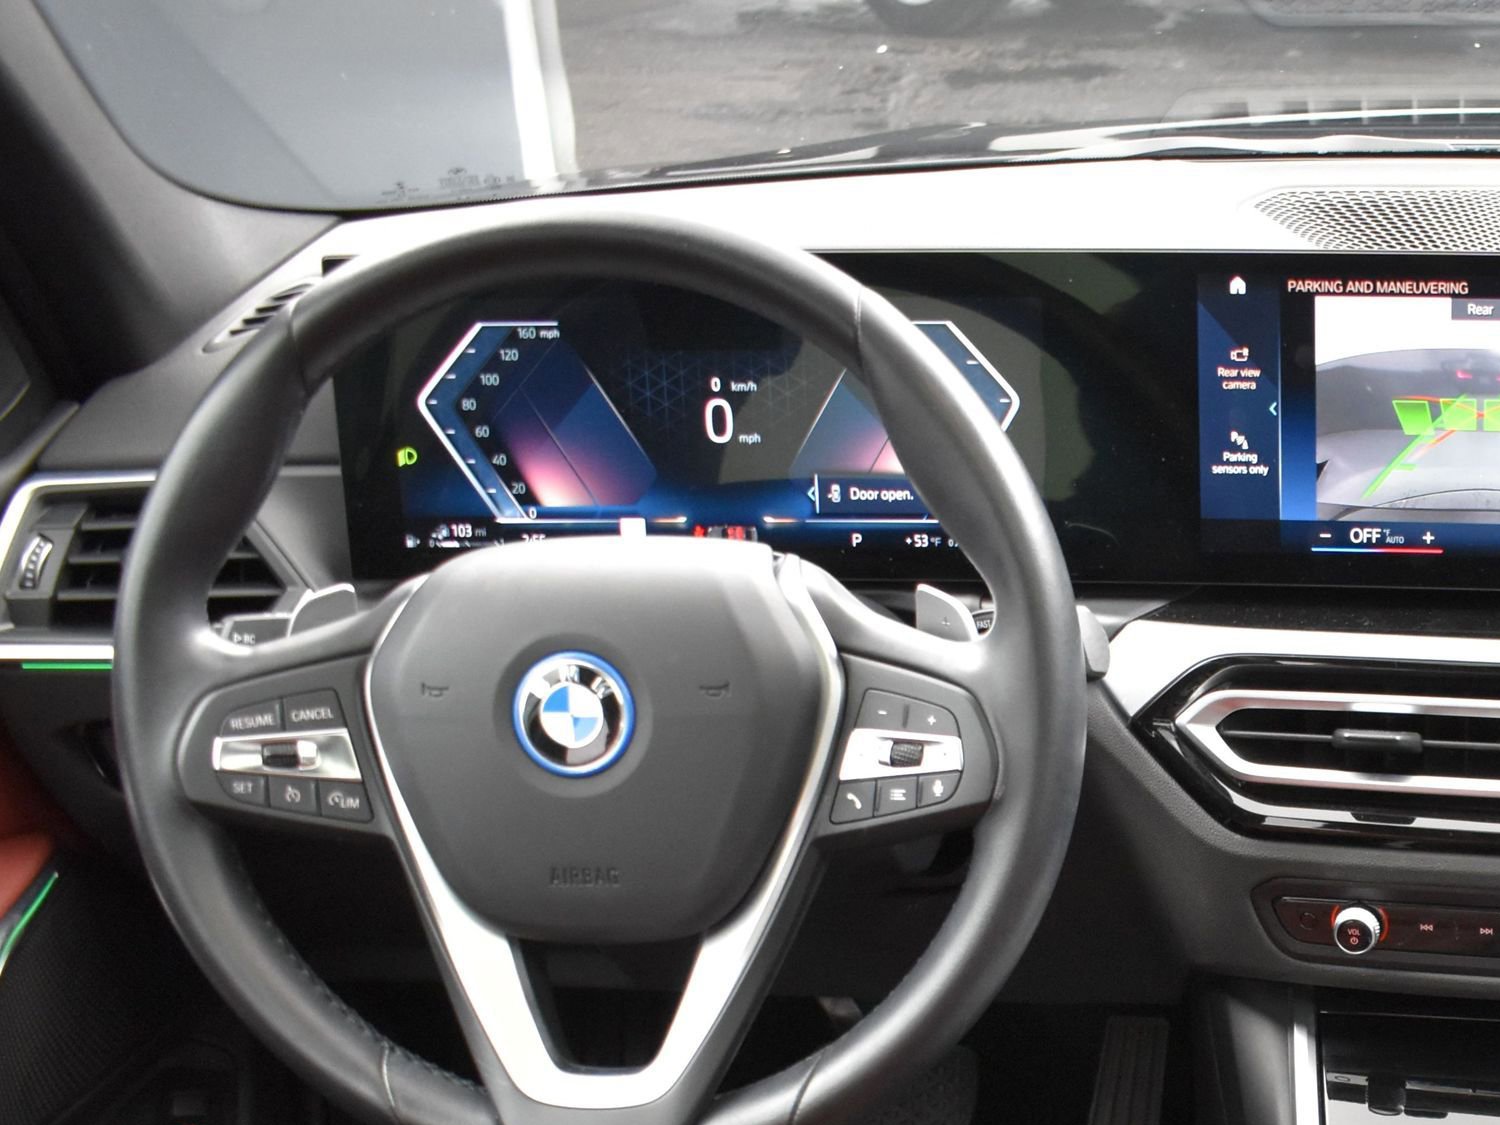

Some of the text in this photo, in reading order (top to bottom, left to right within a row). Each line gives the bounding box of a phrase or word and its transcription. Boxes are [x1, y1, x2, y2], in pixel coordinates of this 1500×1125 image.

[1288, 280, 1469, 294] PARKING AND MANEUVERING
[1467, 303, 1494, 316] Rear
[517, 328, 560, 340] 160 mph
[500, 350, 519, 362] 120
[1218, 367, 1261, 378] Rear view
[480, 373, 500, 386] 100
[710, 376, 758, 392] 0 km/h
[1222, 380, 1256, 390] camera
[462, 399, 476, 411] 80
[704, 398, 761, 445] 0 mph
[475, 426, 490, 438] 60
[492, 454, 507, 466] 40
[1222, 452, 1258, 464] Parking
[1212, 465, 1269, 476] sensors only
[512, 483, 526, 494] 20
[850, 486, 914, 502] Door open.
[528, 508, 538, 519] 0
[451, 524, 487, 538] 103 mi
[1350, 528, 1382, 544] OFF
[852, 533, 862, 548] P
[1386, 536, 1404, 544] AUTO
[291, 708, 334, 722] CANCEL
[230, 714, 276, 731] RESUME
[232, 782, 254, 795] SET
[340, 797, 360, 810] LIM
[550, 866, 621, 887] AIRBAG
[1348, 928, 1361, 936] VOL
